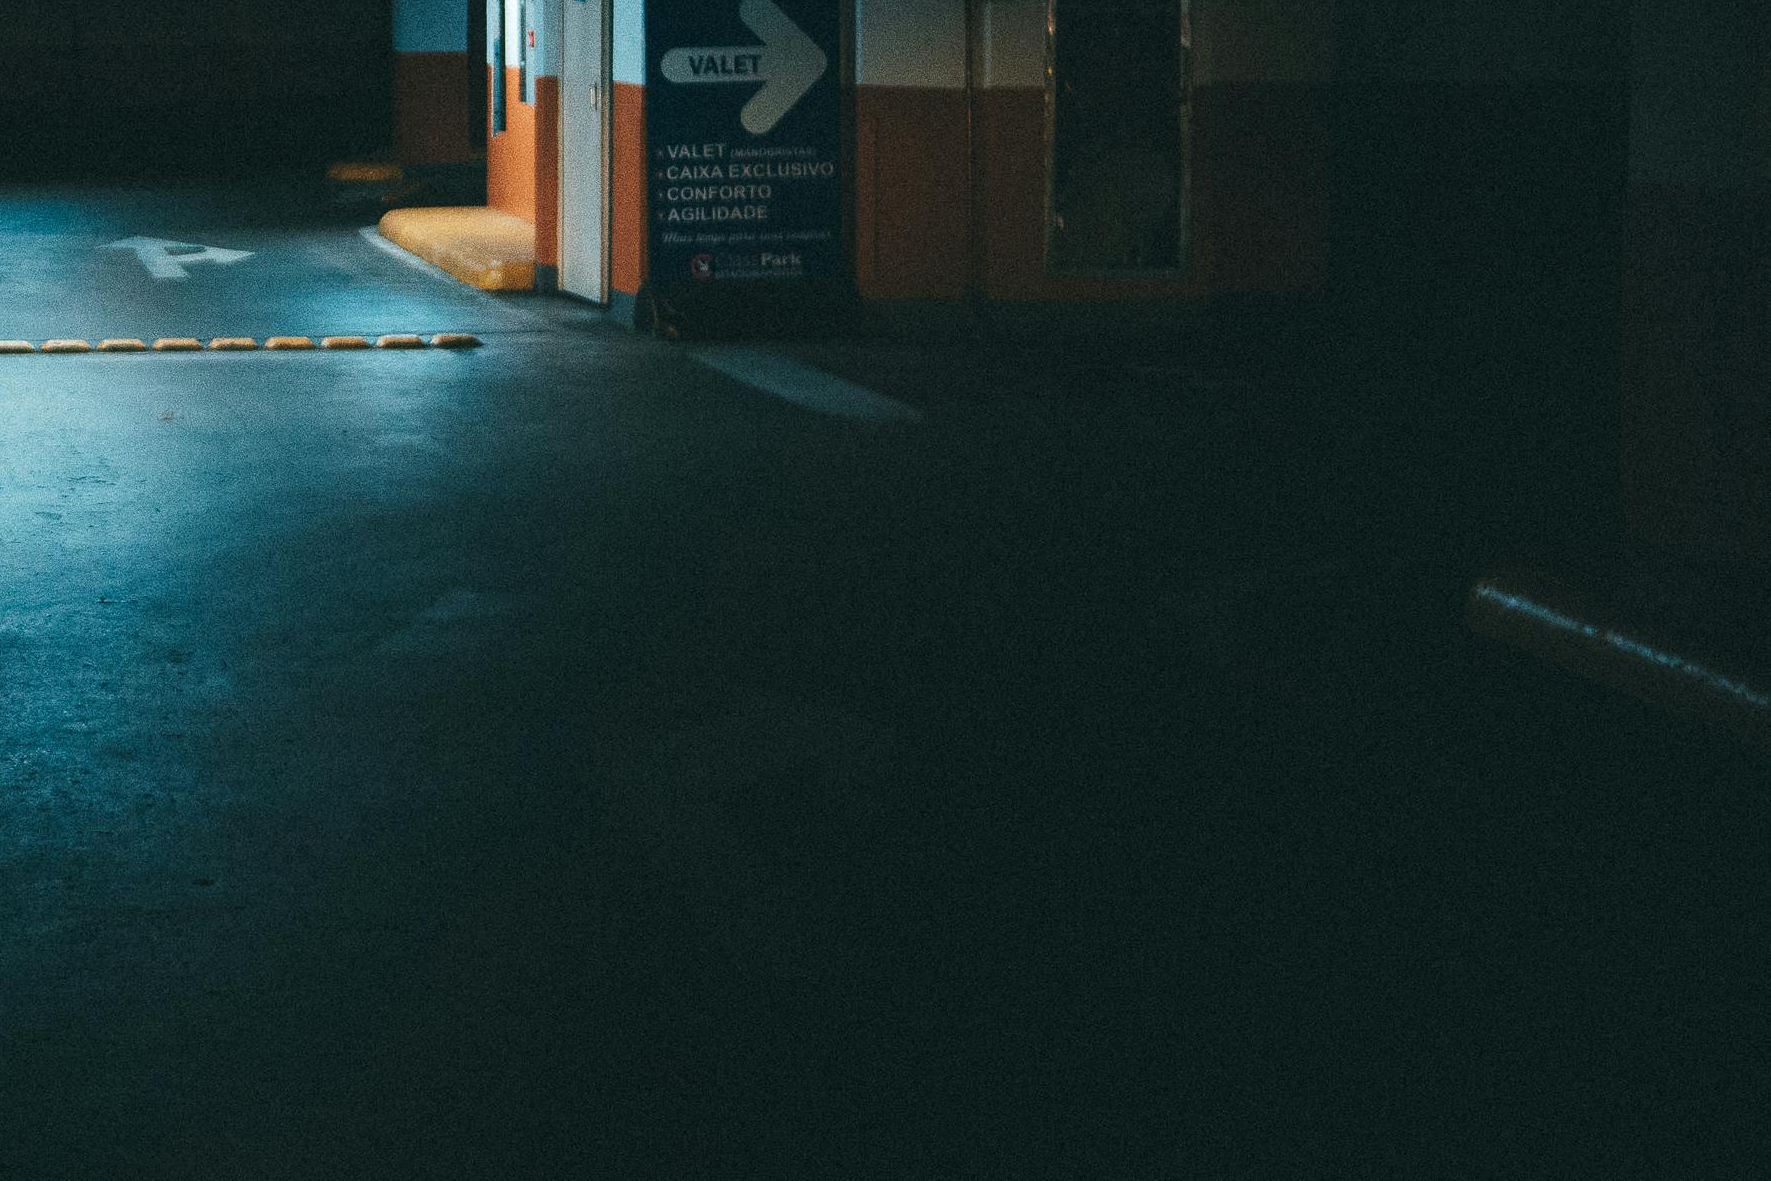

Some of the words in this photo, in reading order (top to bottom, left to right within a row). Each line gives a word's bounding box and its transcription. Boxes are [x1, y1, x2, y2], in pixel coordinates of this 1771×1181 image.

[688, 54, 761, 74] VALET
[667, 144, 725, 159] VALET
[666, 166, 723, 180] CAIXA
[729, 162, 834, 178] EXCLUSIVO
[666, 185, 772, 201] CONFORTO
[667, 206, 768, 221] AGILIDADE
